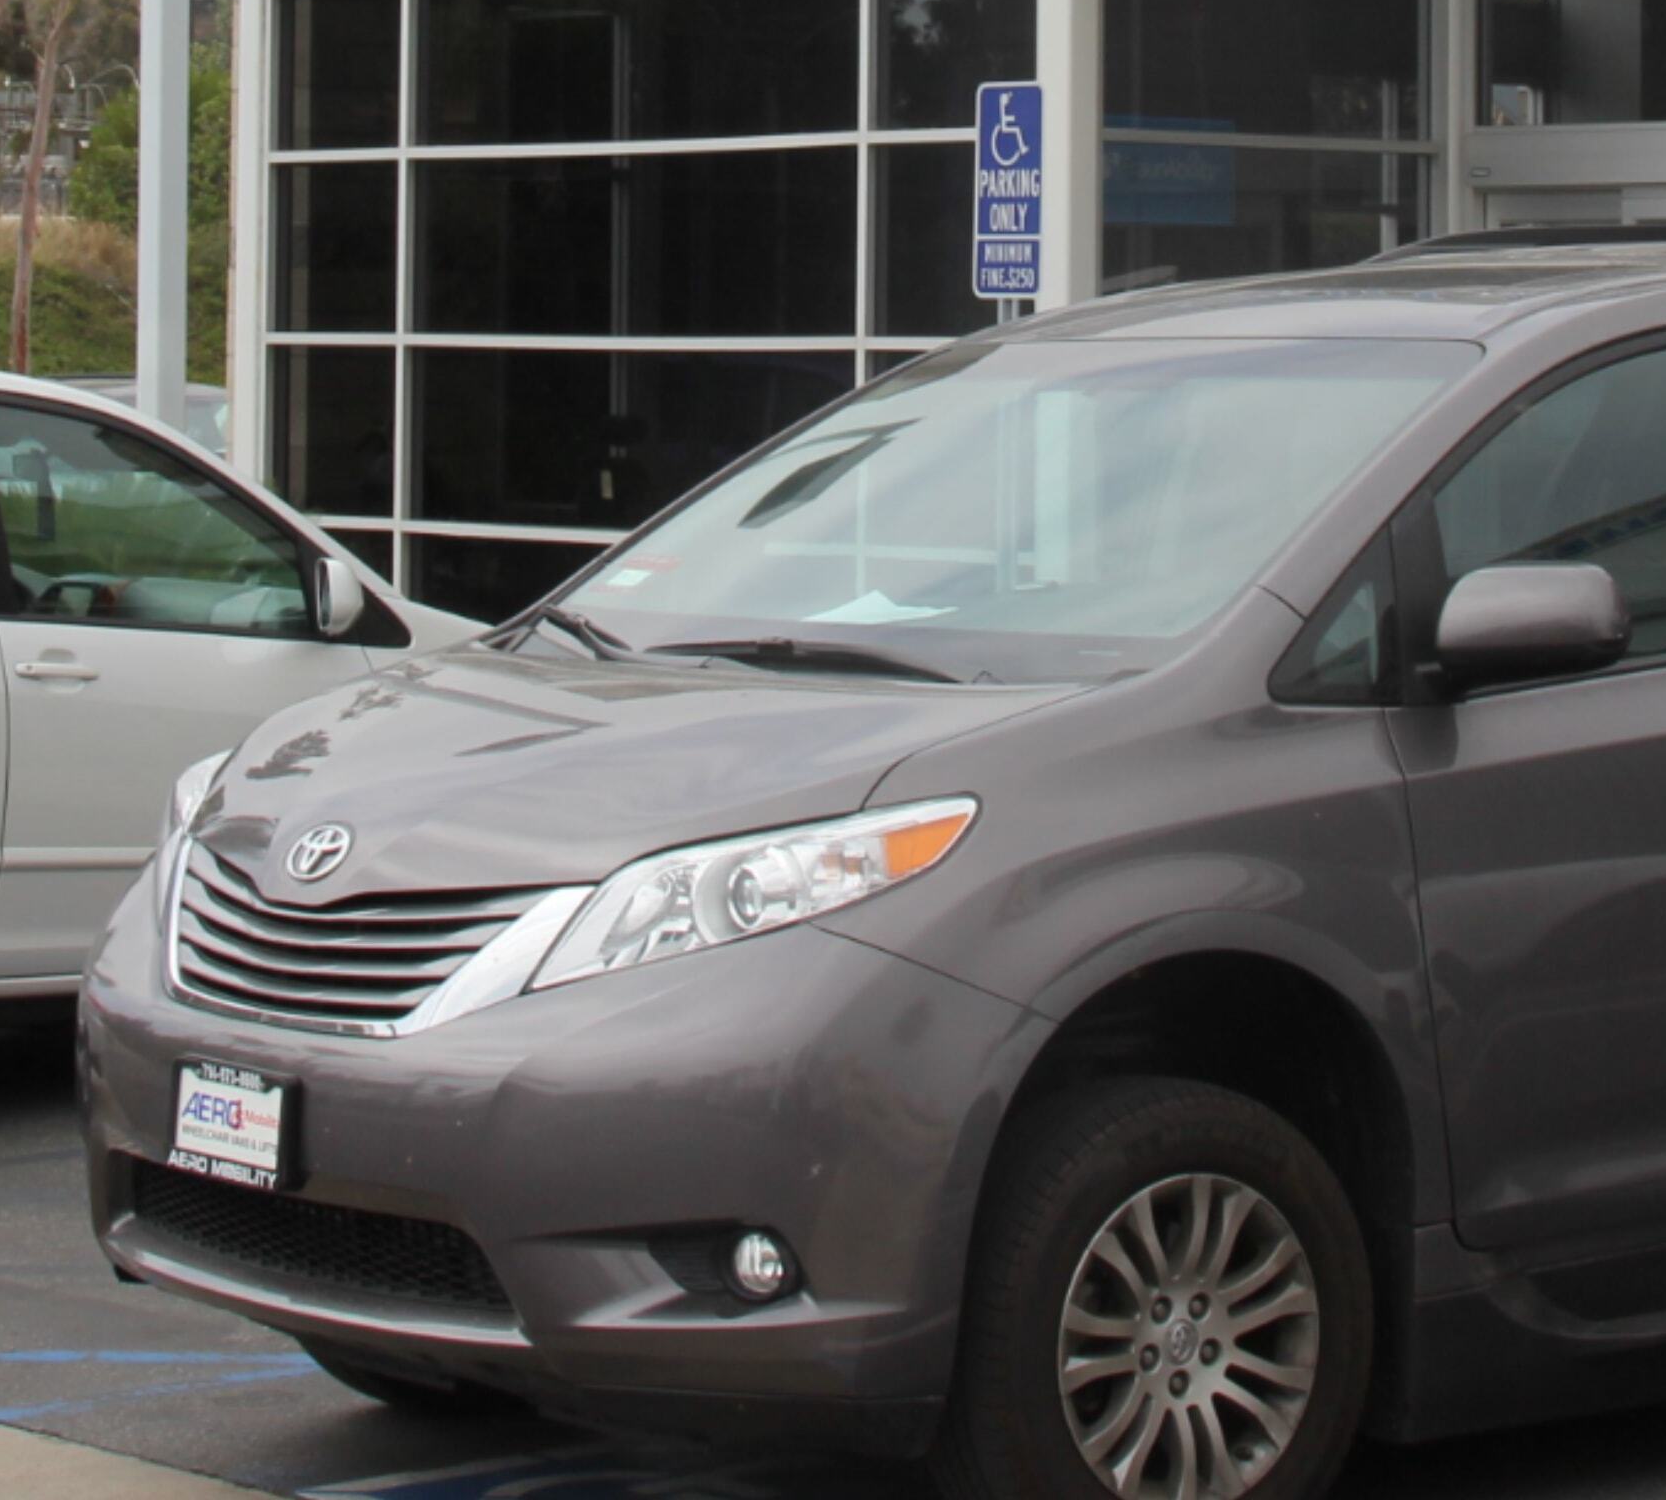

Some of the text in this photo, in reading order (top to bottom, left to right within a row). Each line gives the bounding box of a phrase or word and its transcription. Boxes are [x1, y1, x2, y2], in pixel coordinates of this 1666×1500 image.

[979, 169, 1040, 198] PARKING
[989, 203, 1028, 232] ONLY
[984, 242, 1032, 263] MINIMUM
